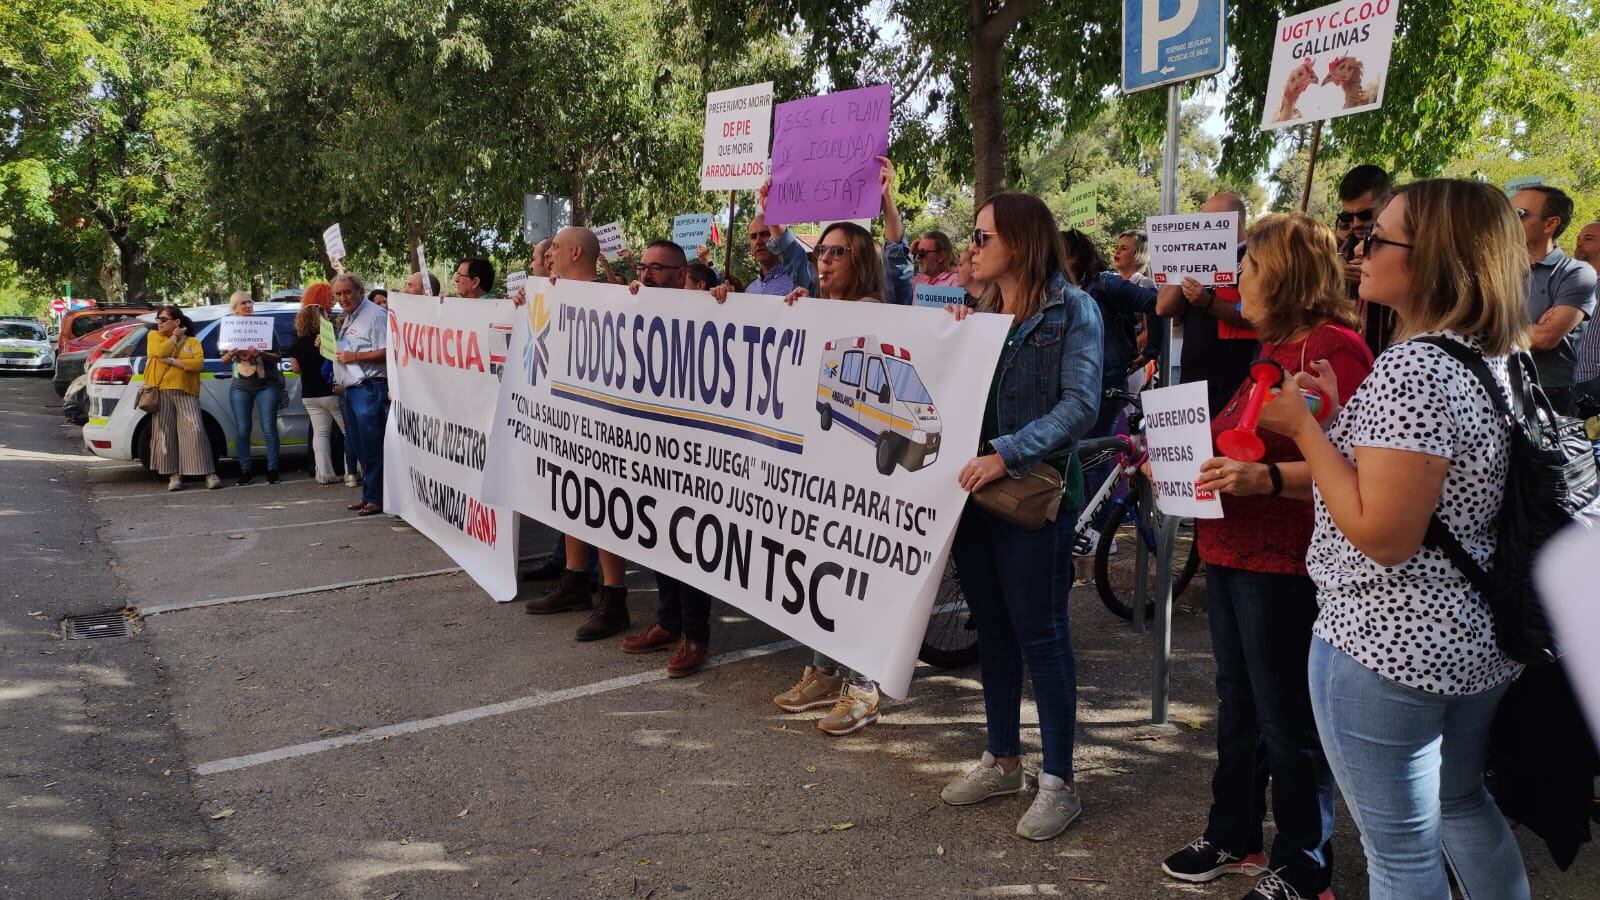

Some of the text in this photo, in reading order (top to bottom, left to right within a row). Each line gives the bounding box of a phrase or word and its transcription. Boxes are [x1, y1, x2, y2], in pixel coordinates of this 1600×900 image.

[1141, 0, 1199, 74] P
[1282, 20, 1313, 42] UGT
[1316, 15, 1326, 32] Y
[1292, 24, 1370, 59] GALLINAS
[708, 94, 771, 115] PREFERIMOS MORIR
[821, 108, 836, 124] EL
[848, 98, 884, 123] PLAN
[723, 120, 751, 137] DE PIE
[718, 142, 753, 156] QUE MORIR
[803, 133, 874, 165] IGUALDAD
[705, 162, 764, 177] ARRODILLADOS
[1151, 219, 1230, 232] DESPIDEN A 40
[1154, 242, 1227, 253] Y CONTRATAN
[1162, 264, 1218, 273] POR FUERA
[1215, 274, 1232, 282] CTA
[925, 294, 963, 305] QUEREMOS
[402, 321, 485, 373] JUSTICIA
[558, 303, 807, 421] "TODOS SOMOS TSC"
[1146, 406, 1206, 429] QUEREMOS
[422, 414, 441, 456] POR
[441, 420, 487, 473] NUESTRO
[531, 402, 541, 422] LA
[541, 403, 571, 432] SALUD
[572, 415, 580, 434] Y
[581, 416, 593, 439] EL
[594, 420, 651, 455] TRABAJO
[656, 434, 680, 461] NO
[683, 440, 702, 466] SE
[705, 445, 756, 481] JUEGA"
[761, 459, 836, 508] "JUSTICIA
[842, 483, 891, 525] PARA
[895, 498, 937, 537] TSC"
[1158, 480, 1193, 498] PIRATAS
[429, 478, 467, 532] SANIDAD
[467, 496, 497, 550] DIGNA
[533, 428, 548, 451] UN
[548, 434, 628, 480] TRANSPORTE
[631, 460, 724, 505] SANITARIO
[726, 485, 774, 524] JUSTO
[777, 502, 788, 530] Y
[790, 508, 820, 542] DE
[823, 519, 932, 577] CALIDAD"
[536, 456, 870, 633] "TODOS CON TSC"
